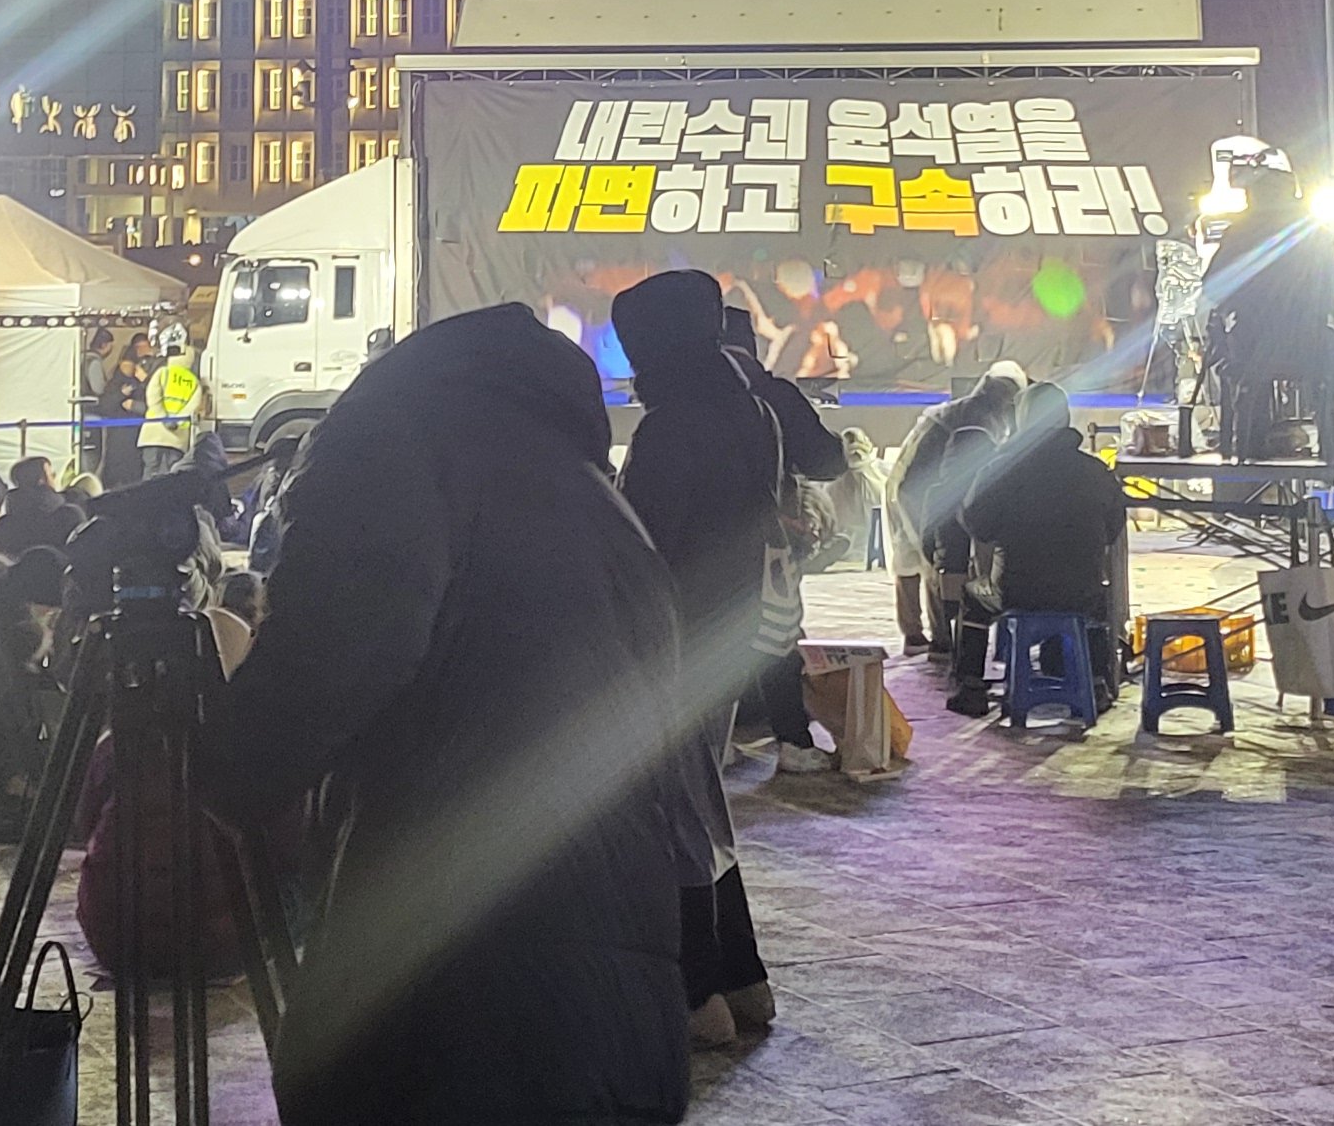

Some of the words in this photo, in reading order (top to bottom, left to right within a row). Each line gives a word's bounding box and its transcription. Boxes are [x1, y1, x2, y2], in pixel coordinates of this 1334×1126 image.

[554, 99, 809, 161] 내란수괴
[826, 98, 1092, 164] 윤석열을
[498, 164, 801, 233] 파면하고
[825, 165, 1170, 236] 구속하라!
